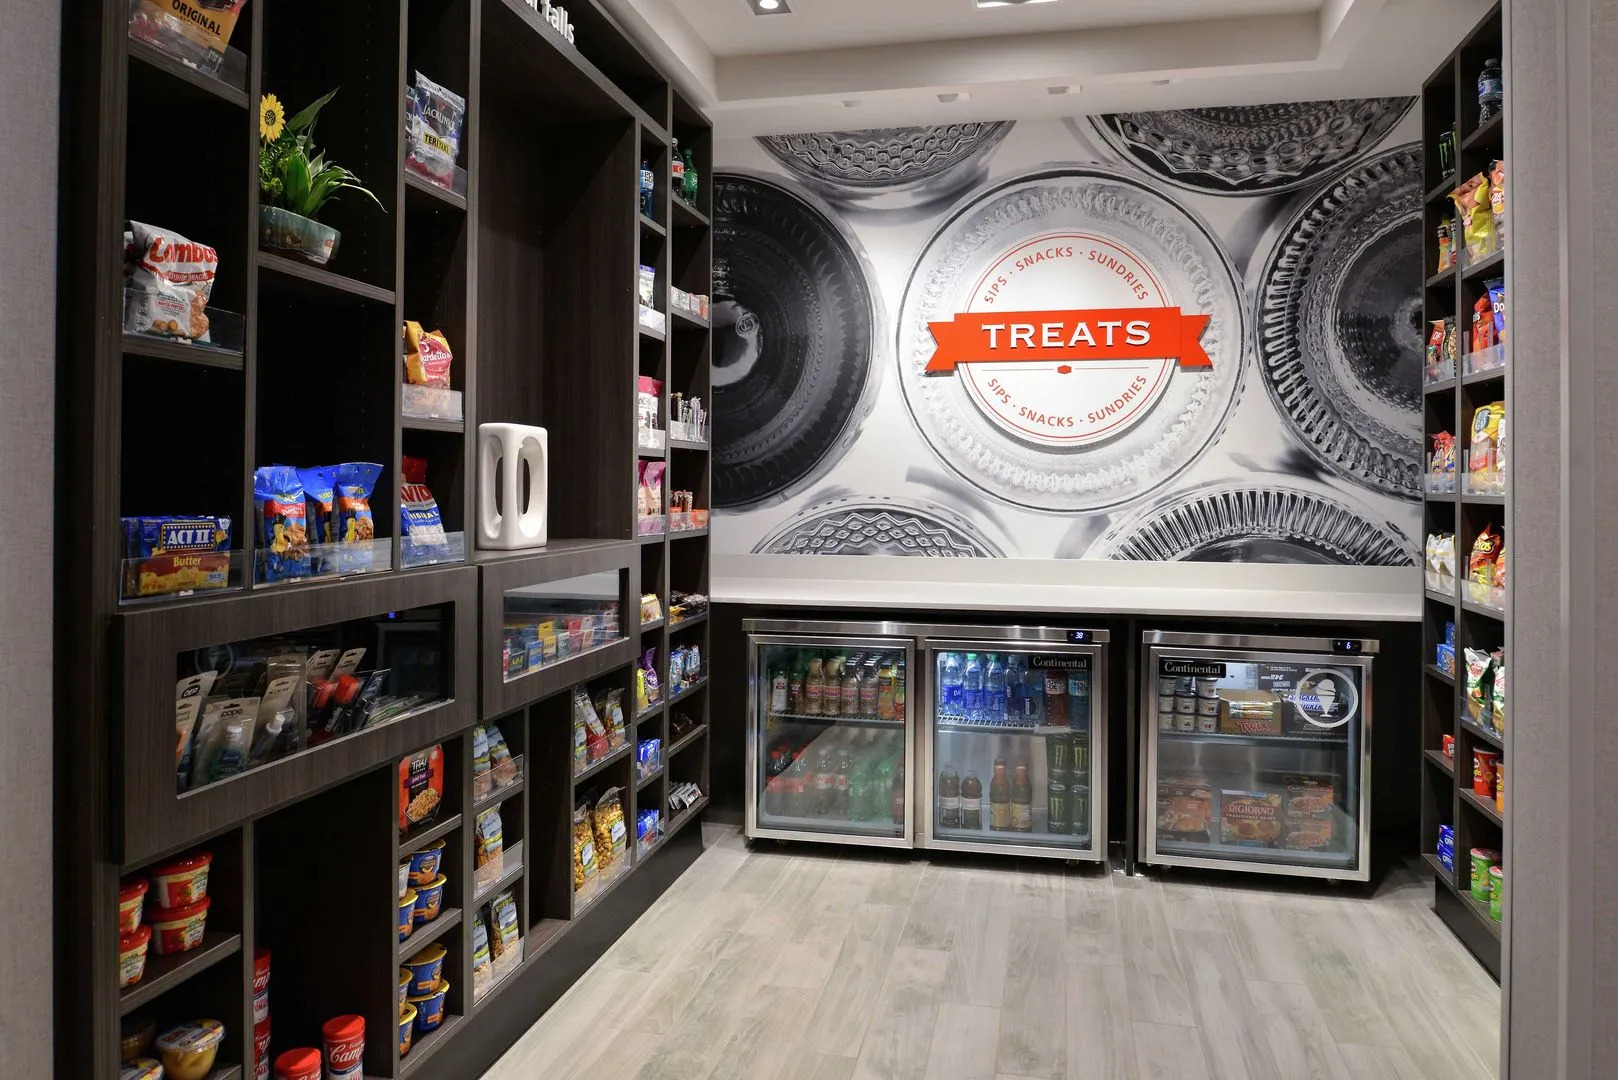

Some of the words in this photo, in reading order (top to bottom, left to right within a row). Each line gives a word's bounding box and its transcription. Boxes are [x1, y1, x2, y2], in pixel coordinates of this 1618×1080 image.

[172, 0, 221, 35] ORIGINAL
[984, 276, 1007, 304] SIPS
[1015, 246, 1073, 272] SNACKS
[1088, 250, 1149, 300] SUNDRIES
[981, 320, 1151, 349] TREATS
[987, 378, 1011, 404] SIPS
[1018, 406, 1074, 427] SNACKS
[1088, 375, 1147, 423] SUNDRIES
[167, 530, 194, 545] ACT
[195, 529, 211, 544] II
[173, 556, 202, 567] Butter
[1033, 656, 1087, 668] Continental
[1164, 661, 1221, 674] Continental
[1237, 721, 1270, 734] Twix
